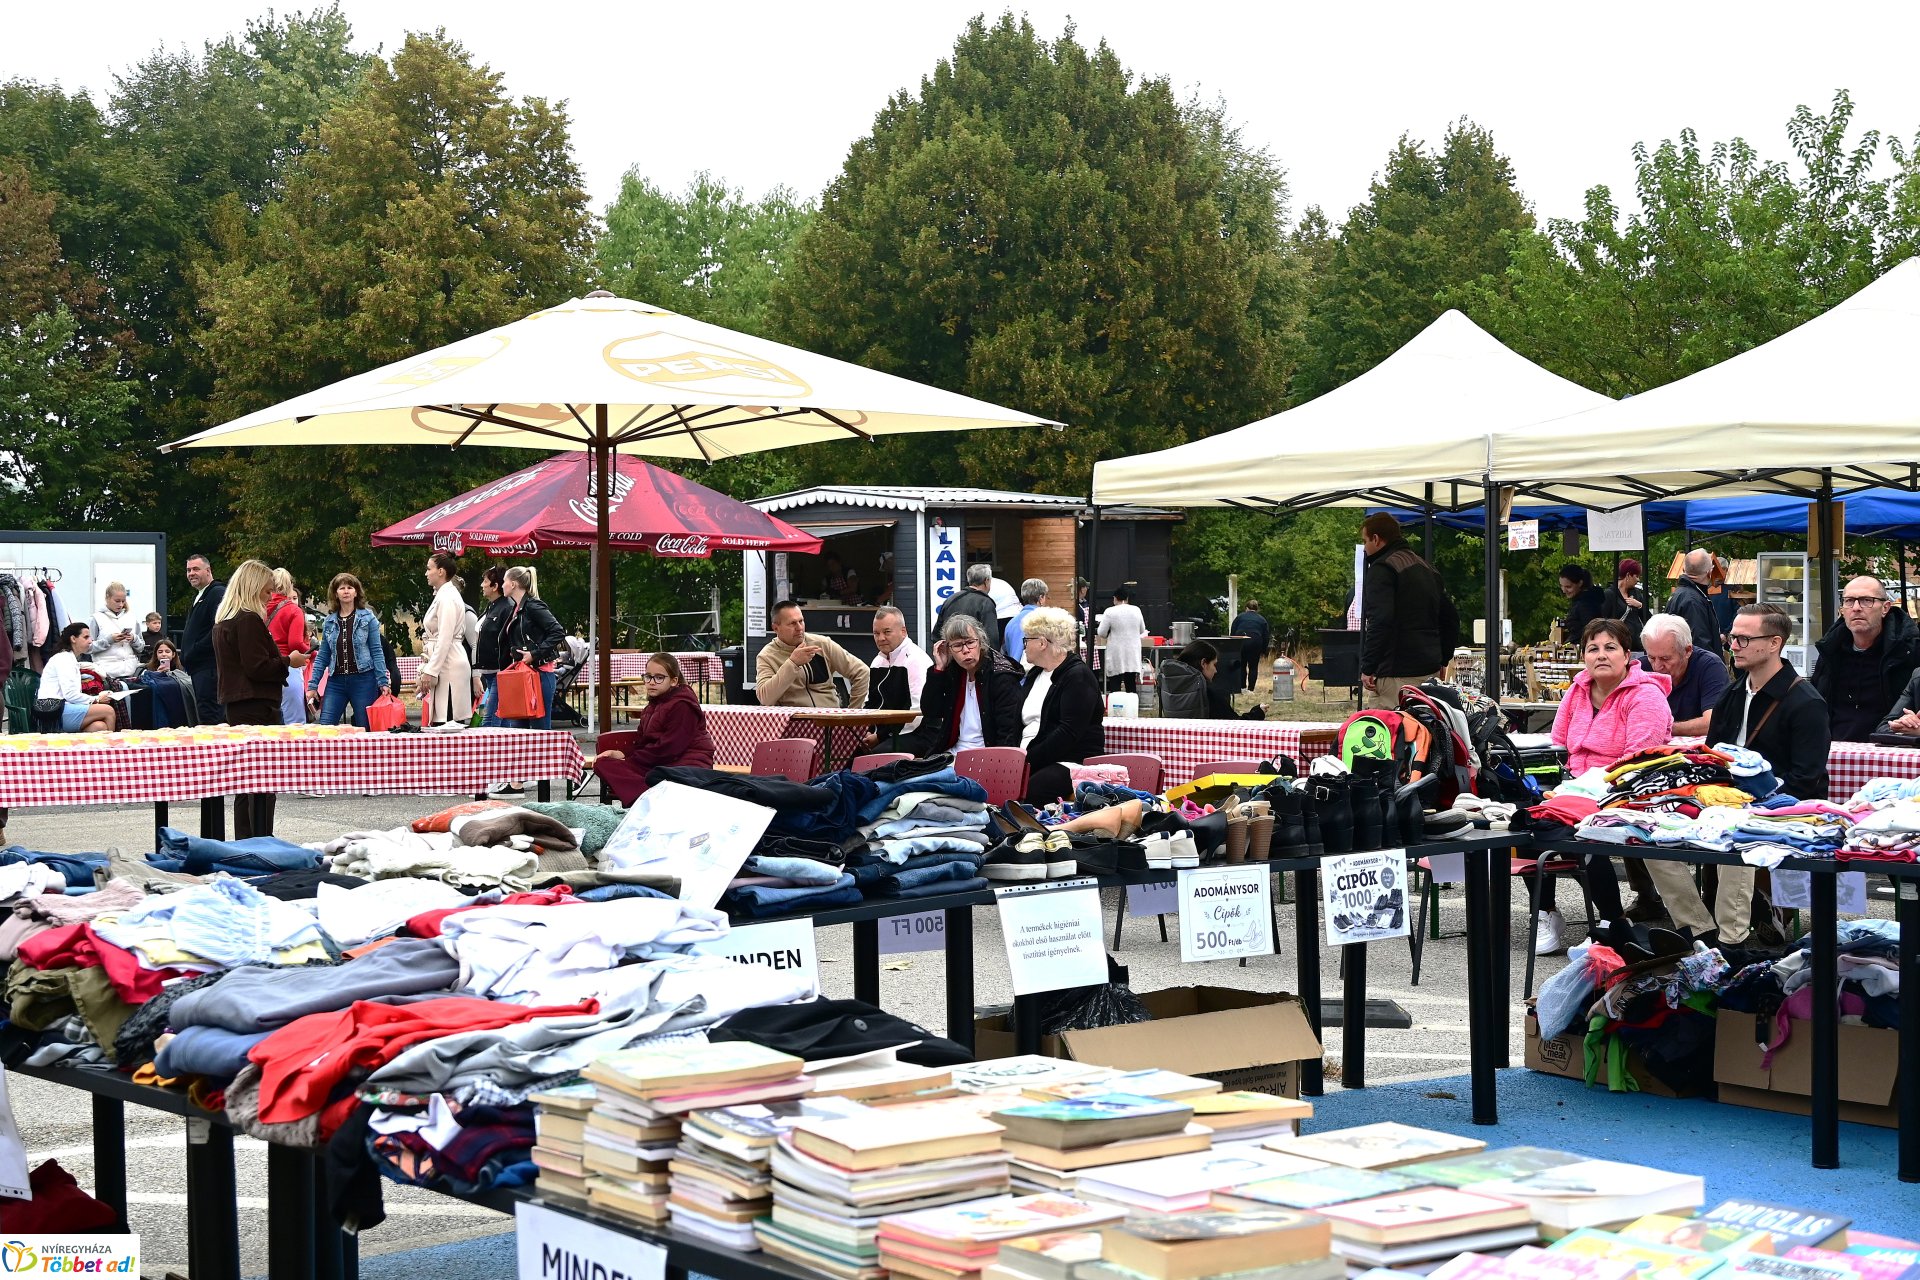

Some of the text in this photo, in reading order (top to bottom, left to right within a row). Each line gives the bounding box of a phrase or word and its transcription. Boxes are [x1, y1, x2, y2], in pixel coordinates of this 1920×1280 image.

[434, 531, 463, 551] Coca-Cola
[469, 532, 500, 543] SOLD HERE
[617, 532, 642, 541] COLD
[655, 533, 710, 555] Coca-Cola
[721, 537, 744, 546] SOLD
[1337, 868, 1378, 891] CIPŐK
[1193, 883, 1260, 898] ADOMÁNYSOR
[1342, 888, 1372, 909] 1000
[1213, 904, 1242, 923] Cipők
[1020, 925, 1026, 933] A
[1026, 922, 1053, 933] termékek
[1012, 930, 1092, 948] okokból első használat előtt
[1196, 930, 1228, 950] 500
[1704, 1201, 1833, 1237] DOUGLAS
